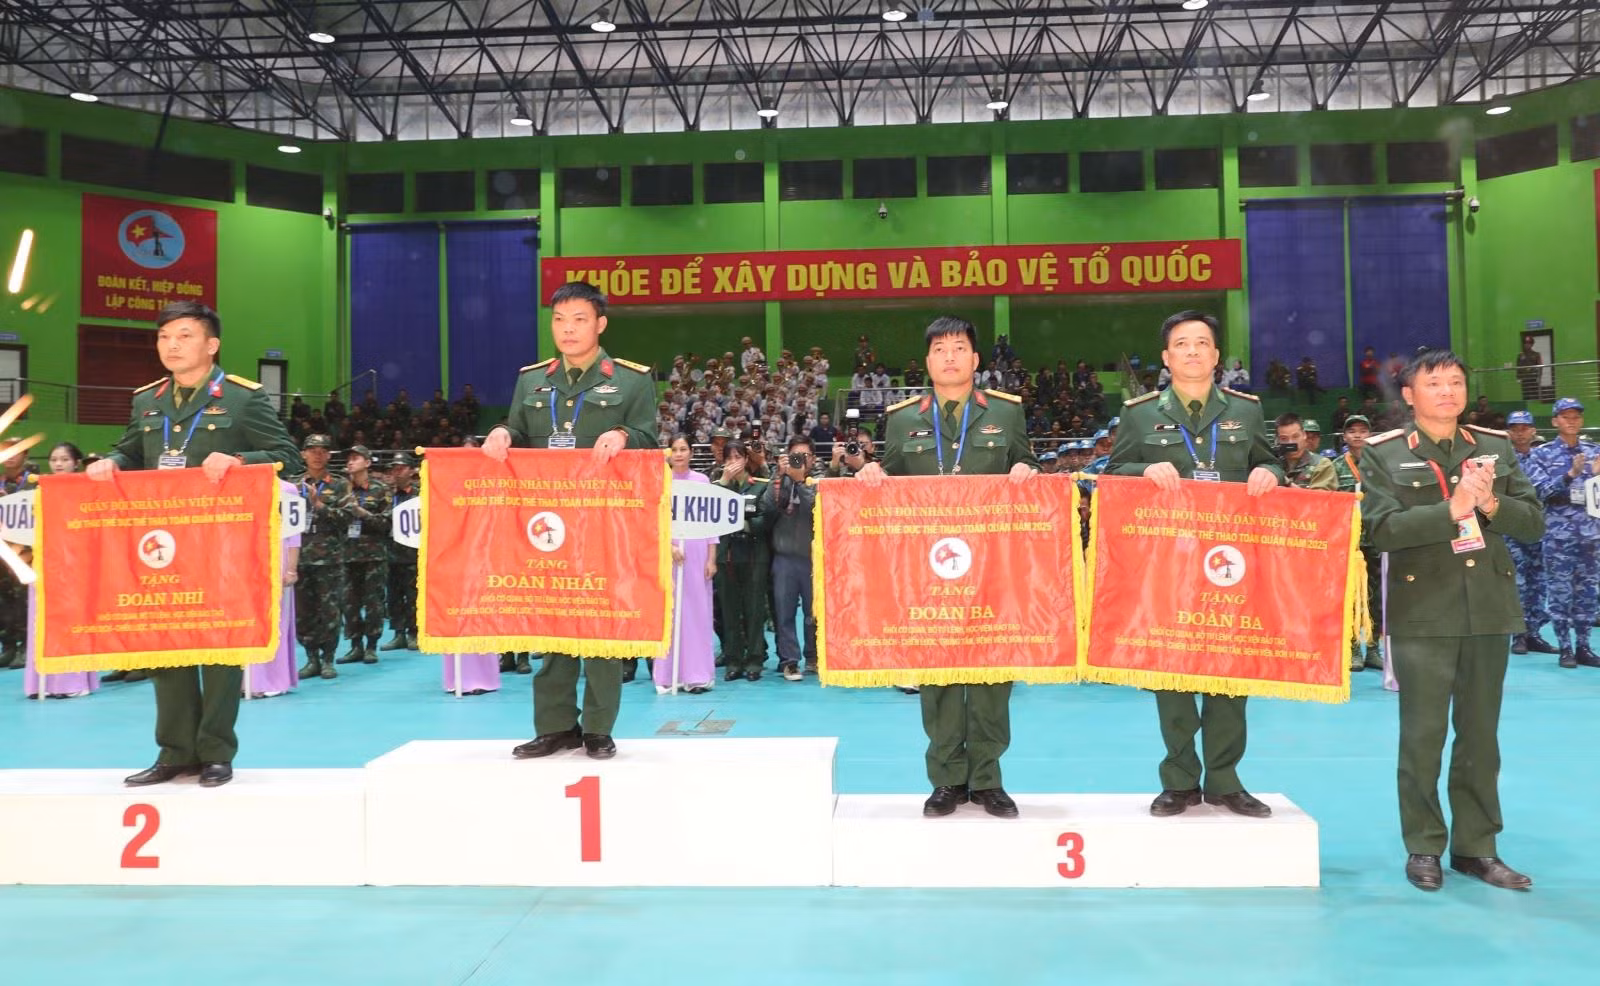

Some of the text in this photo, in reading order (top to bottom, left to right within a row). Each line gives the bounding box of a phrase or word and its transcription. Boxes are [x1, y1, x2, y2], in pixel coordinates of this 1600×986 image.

[661, 257, 703, 294] ĐỂ
[712, 260, 776, 293] XÂY
[787, 261, 877, 297] DỰNG
[887, 255, 931, 288] VÀ
[941, 250, 1007, 287] BẢO
[1018, 252, 1059, 291] VỆ
[1069, 246, 1110, 285] TỔ
[1121, 245, 1212, 286] QUỐC
[609, 480, 633, 490] NAM
[217, 496, 243, 506] NAM
[685, 495, 721, 523] KHU
[728, 498, 739, 524] 9
[1013, 504, 1040, 514] NAM
[289, 501, 299, 527] 5
[1289, 519, 1318, 531] NAM
[1307, 539, 1328, 550] 2025
[526, 558, 568, 571] TẶNG
[487, 571, 607, 591] ĐOÀN NHẤT
[116, 590, 166, 607] ĐOÀN
[1200, 591, 1247, 605] TẶNG
[908, 601, 995, 620] ĐOÀN BA
[1177, 608, 1265, 630] ĐOÀN BA
[564, 776, 602, 862] 1
[120, 804, 160, 868] 2
[1056, 832, 1085, 878] 3
